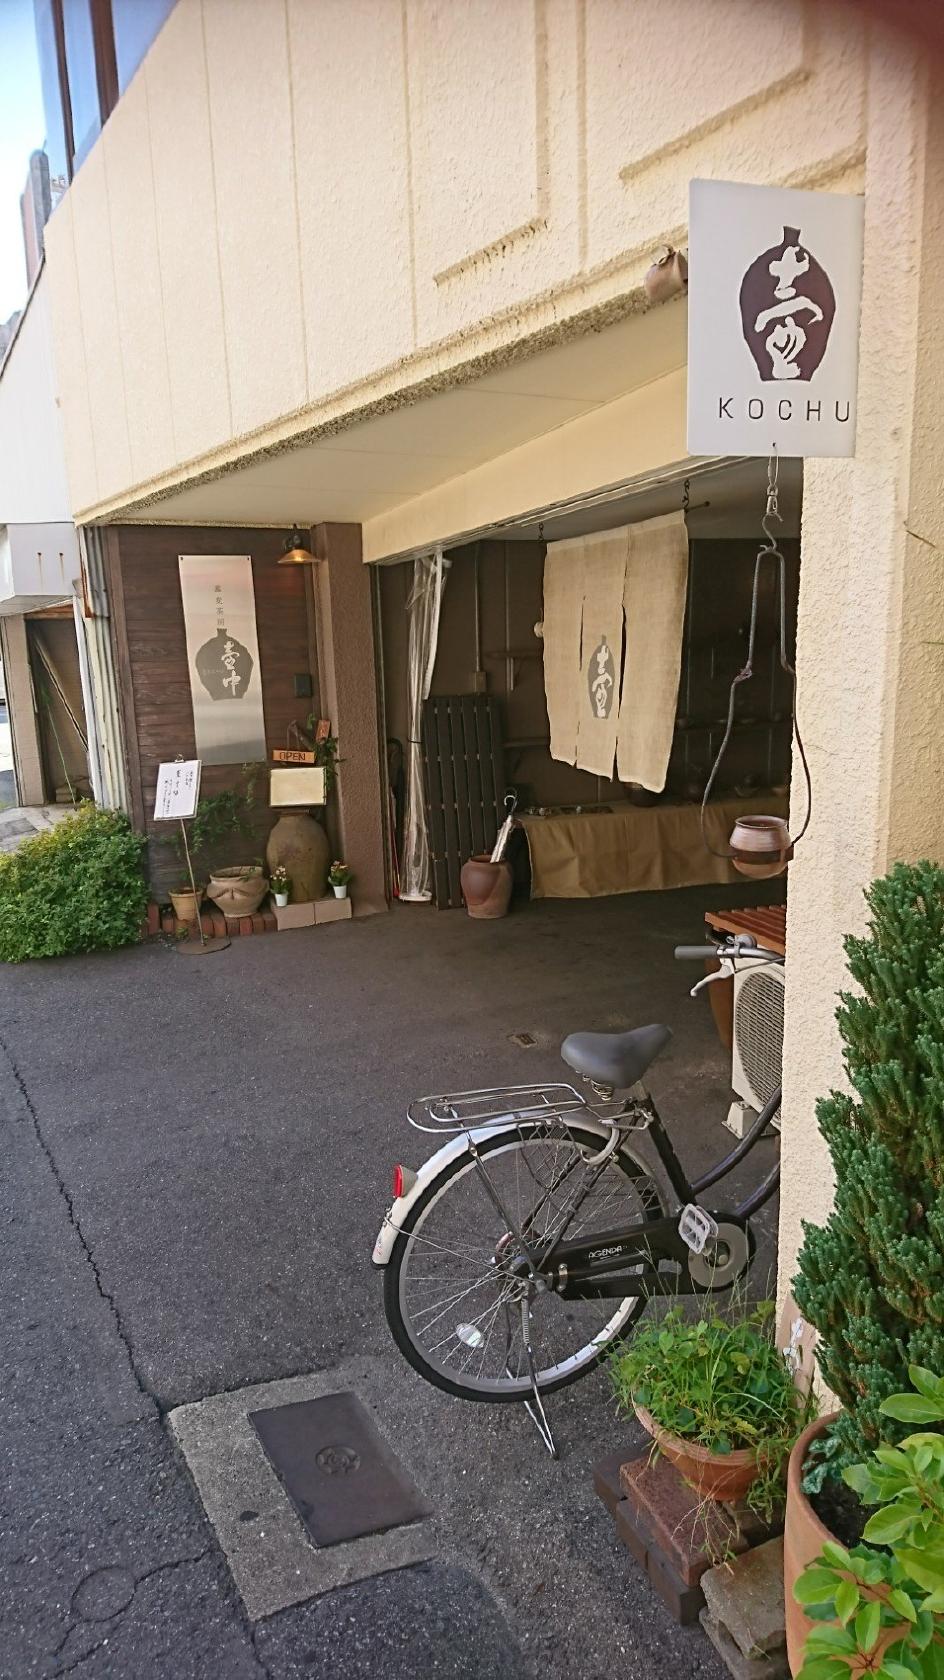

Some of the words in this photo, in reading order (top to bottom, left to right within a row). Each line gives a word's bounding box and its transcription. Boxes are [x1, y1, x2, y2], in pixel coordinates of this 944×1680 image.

[718, 397, 850, 422] KOCHU
[279, 751, 306, 761] OPEN
[588, 1245, 622, 1259] AGENDA
